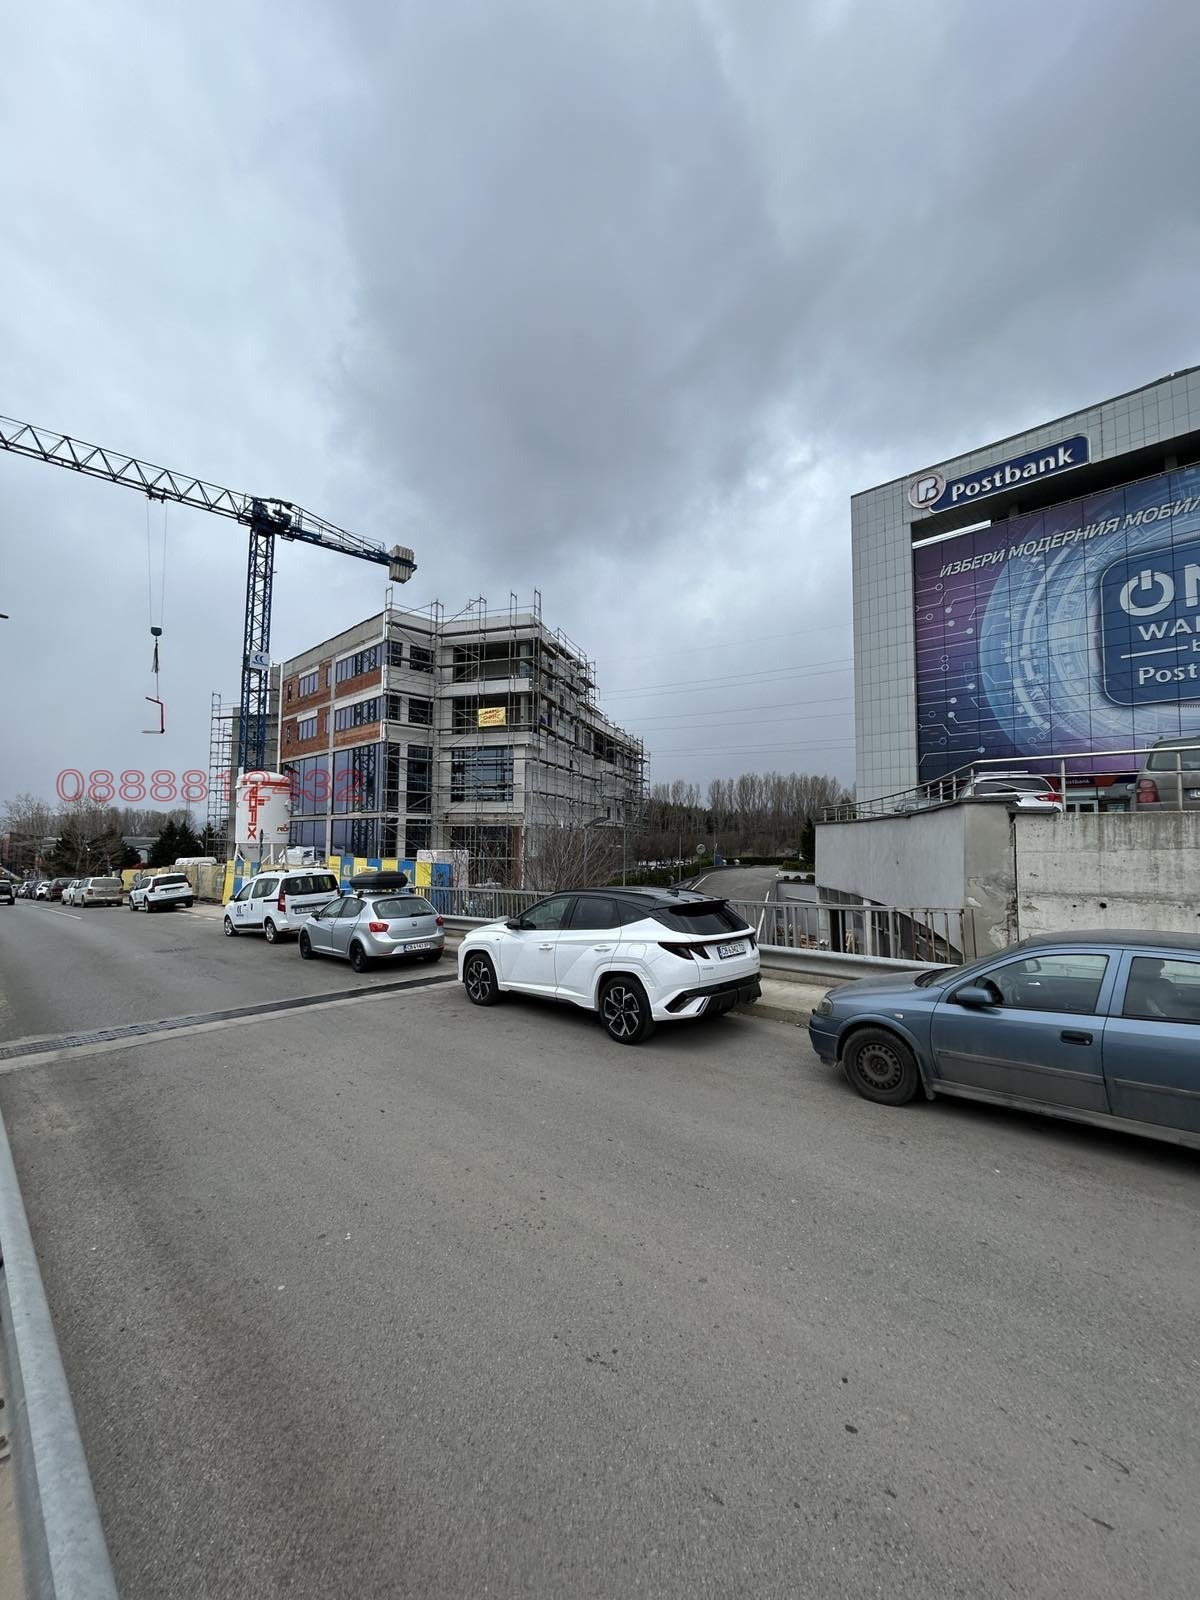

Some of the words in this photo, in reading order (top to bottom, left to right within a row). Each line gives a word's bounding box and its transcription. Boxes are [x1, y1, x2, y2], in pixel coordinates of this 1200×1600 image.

[951, 446, 1075, 502] Postbank
[939, 549, 1005, 578] ИЗБЕРИ
[1008, 517, 1122, 560] МОДЕРНИЯ
